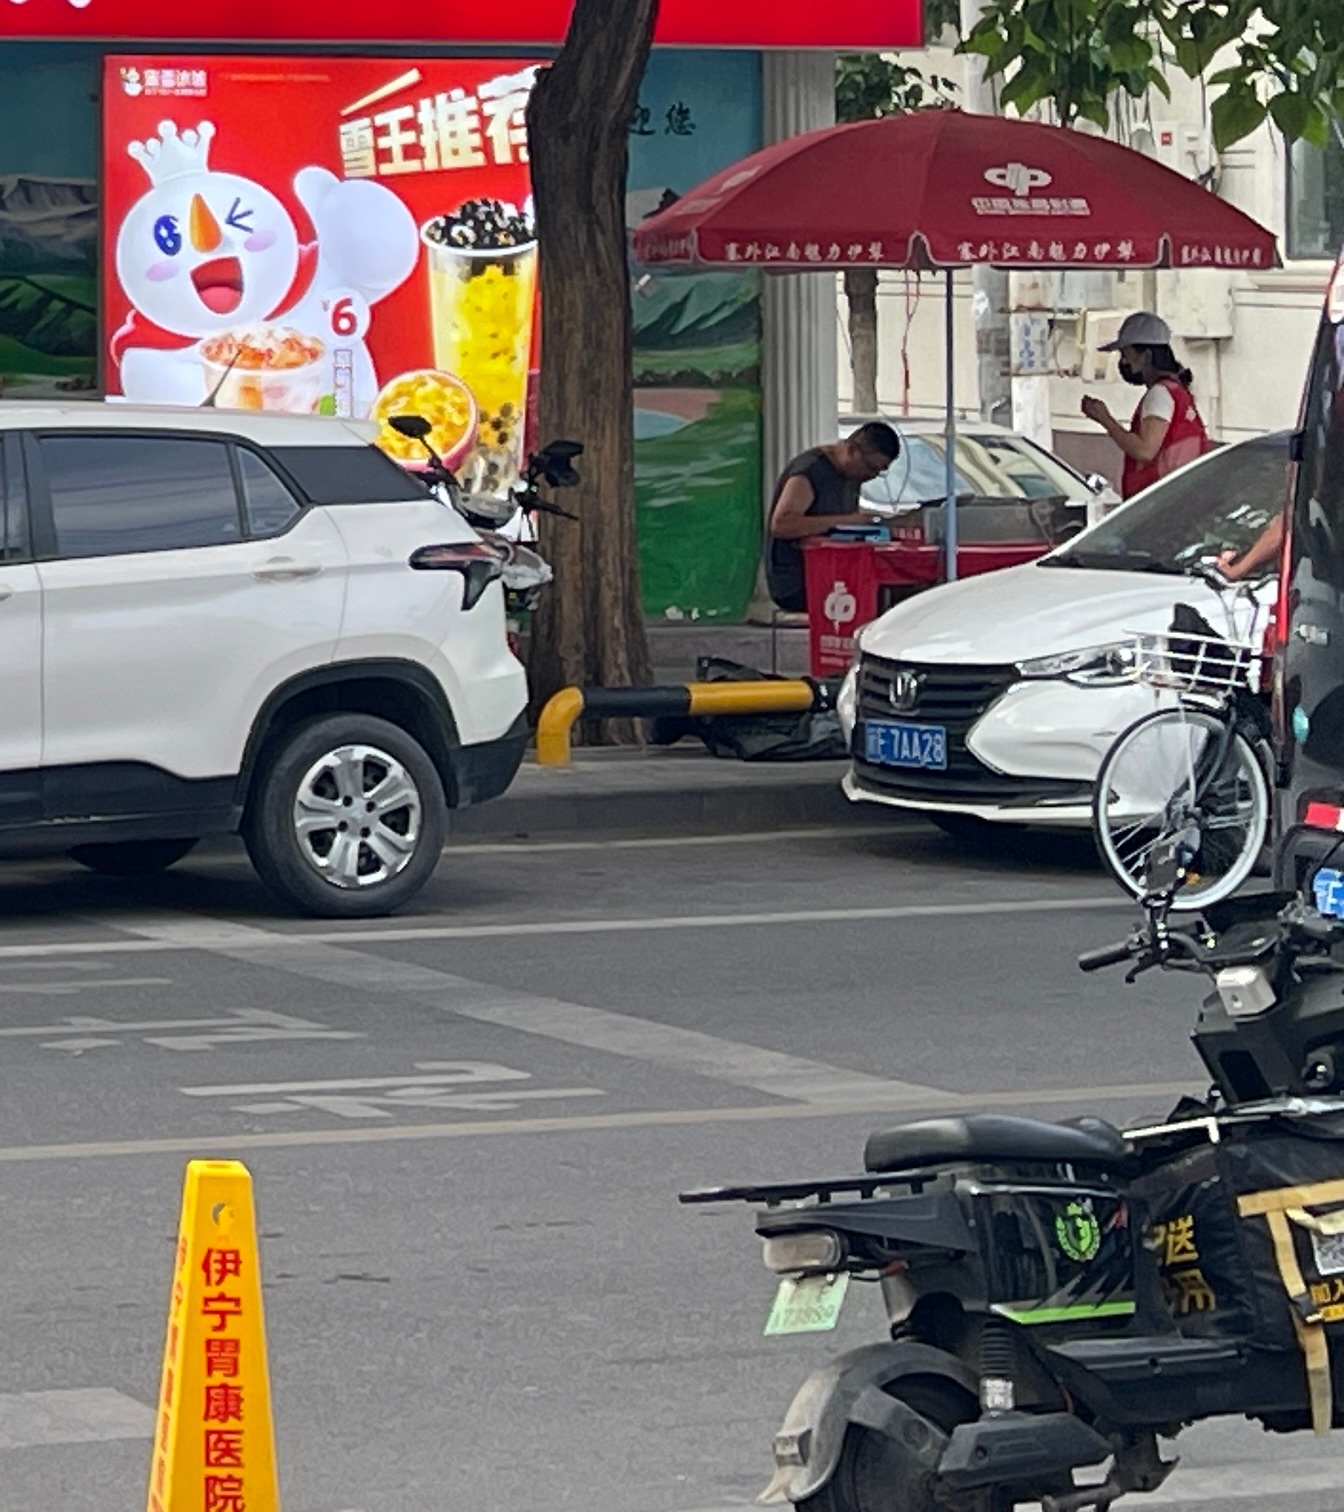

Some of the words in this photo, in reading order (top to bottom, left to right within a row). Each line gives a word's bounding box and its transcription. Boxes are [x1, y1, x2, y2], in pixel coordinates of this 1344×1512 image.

[201, 1248, 245, 1512] 伊宁胃康医院
